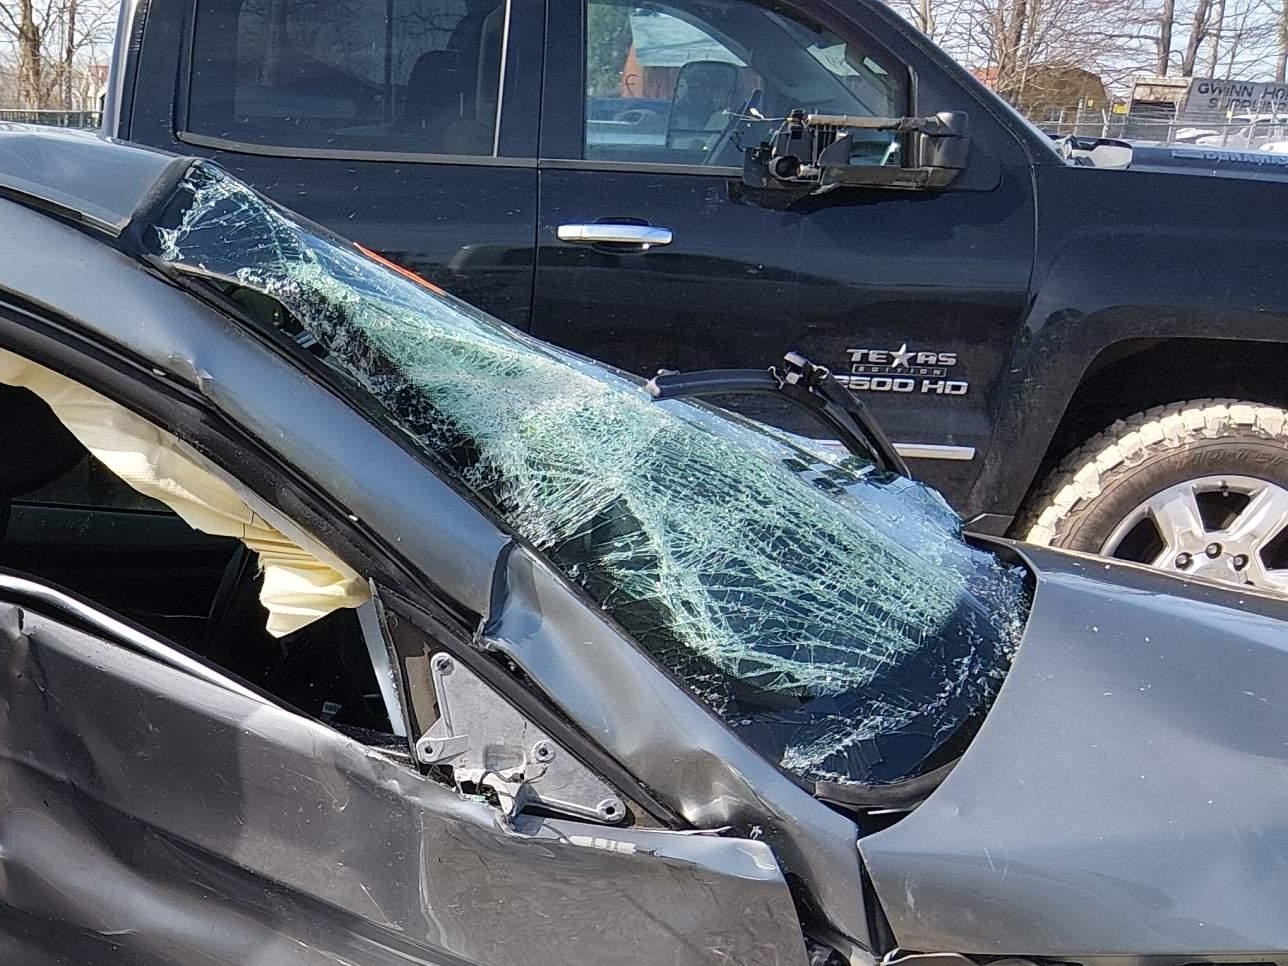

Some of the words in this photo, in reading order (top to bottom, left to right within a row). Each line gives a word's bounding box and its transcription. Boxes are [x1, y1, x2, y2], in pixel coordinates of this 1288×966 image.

[1262, 86, 1288, 101] HO
[858, 366, 942, 375] EDITION
[920, 379, 969, 395] HD
